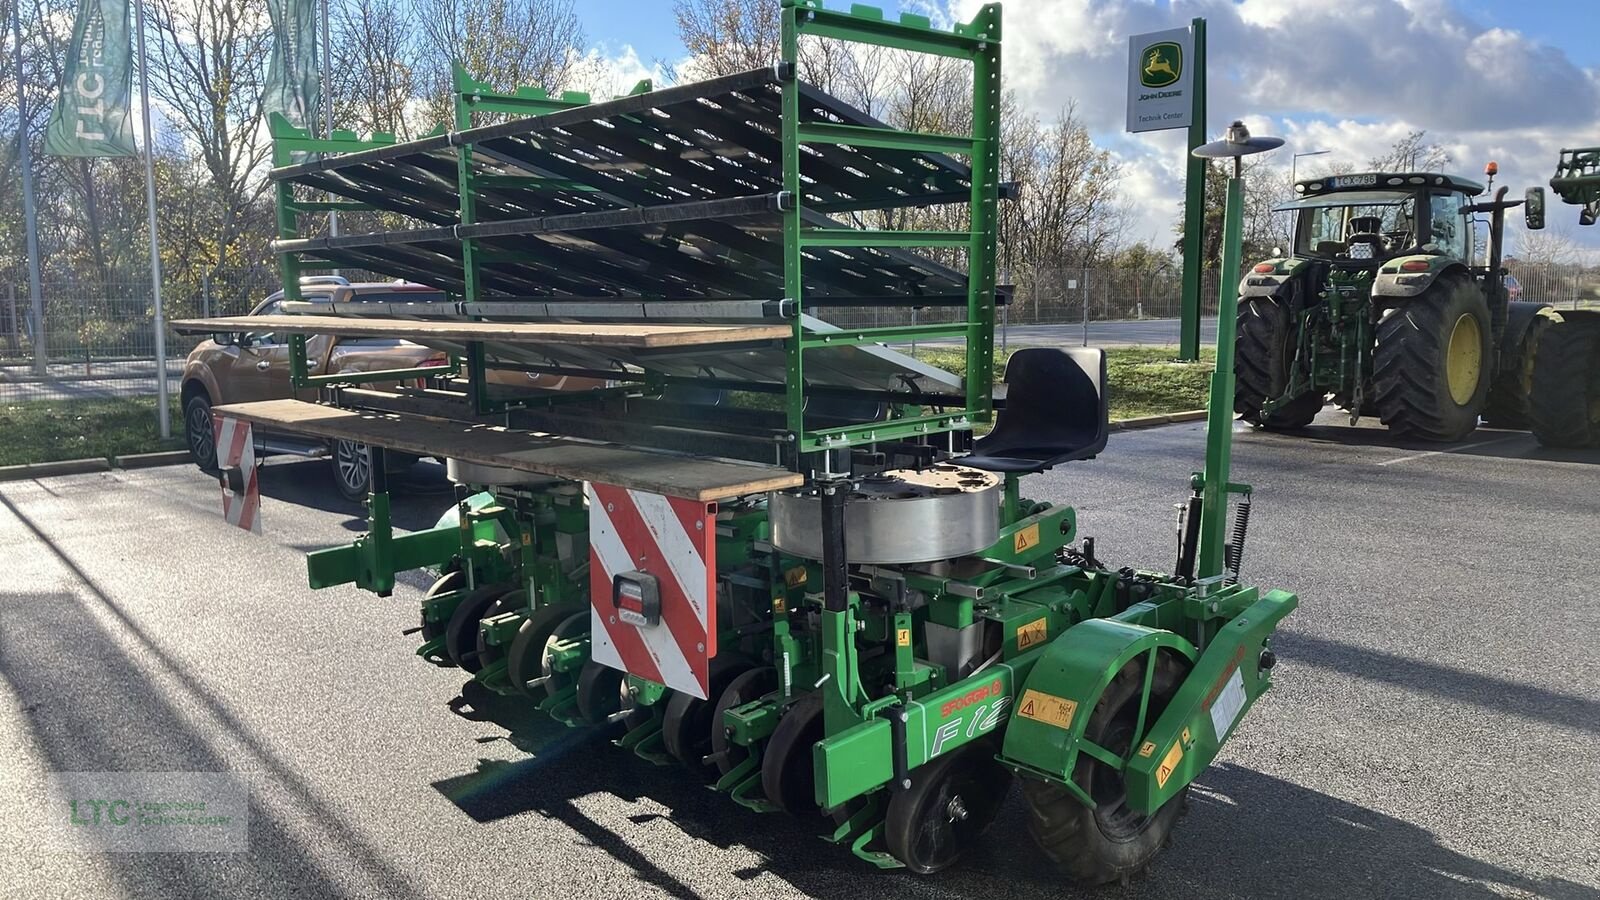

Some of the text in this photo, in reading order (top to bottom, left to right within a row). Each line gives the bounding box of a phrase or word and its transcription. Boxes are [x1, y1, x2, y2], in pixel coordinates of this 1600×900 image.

[1138, 90, 1182, 101] JOHN DEERE
[1139, 112, 1184, 122] Technik Center
